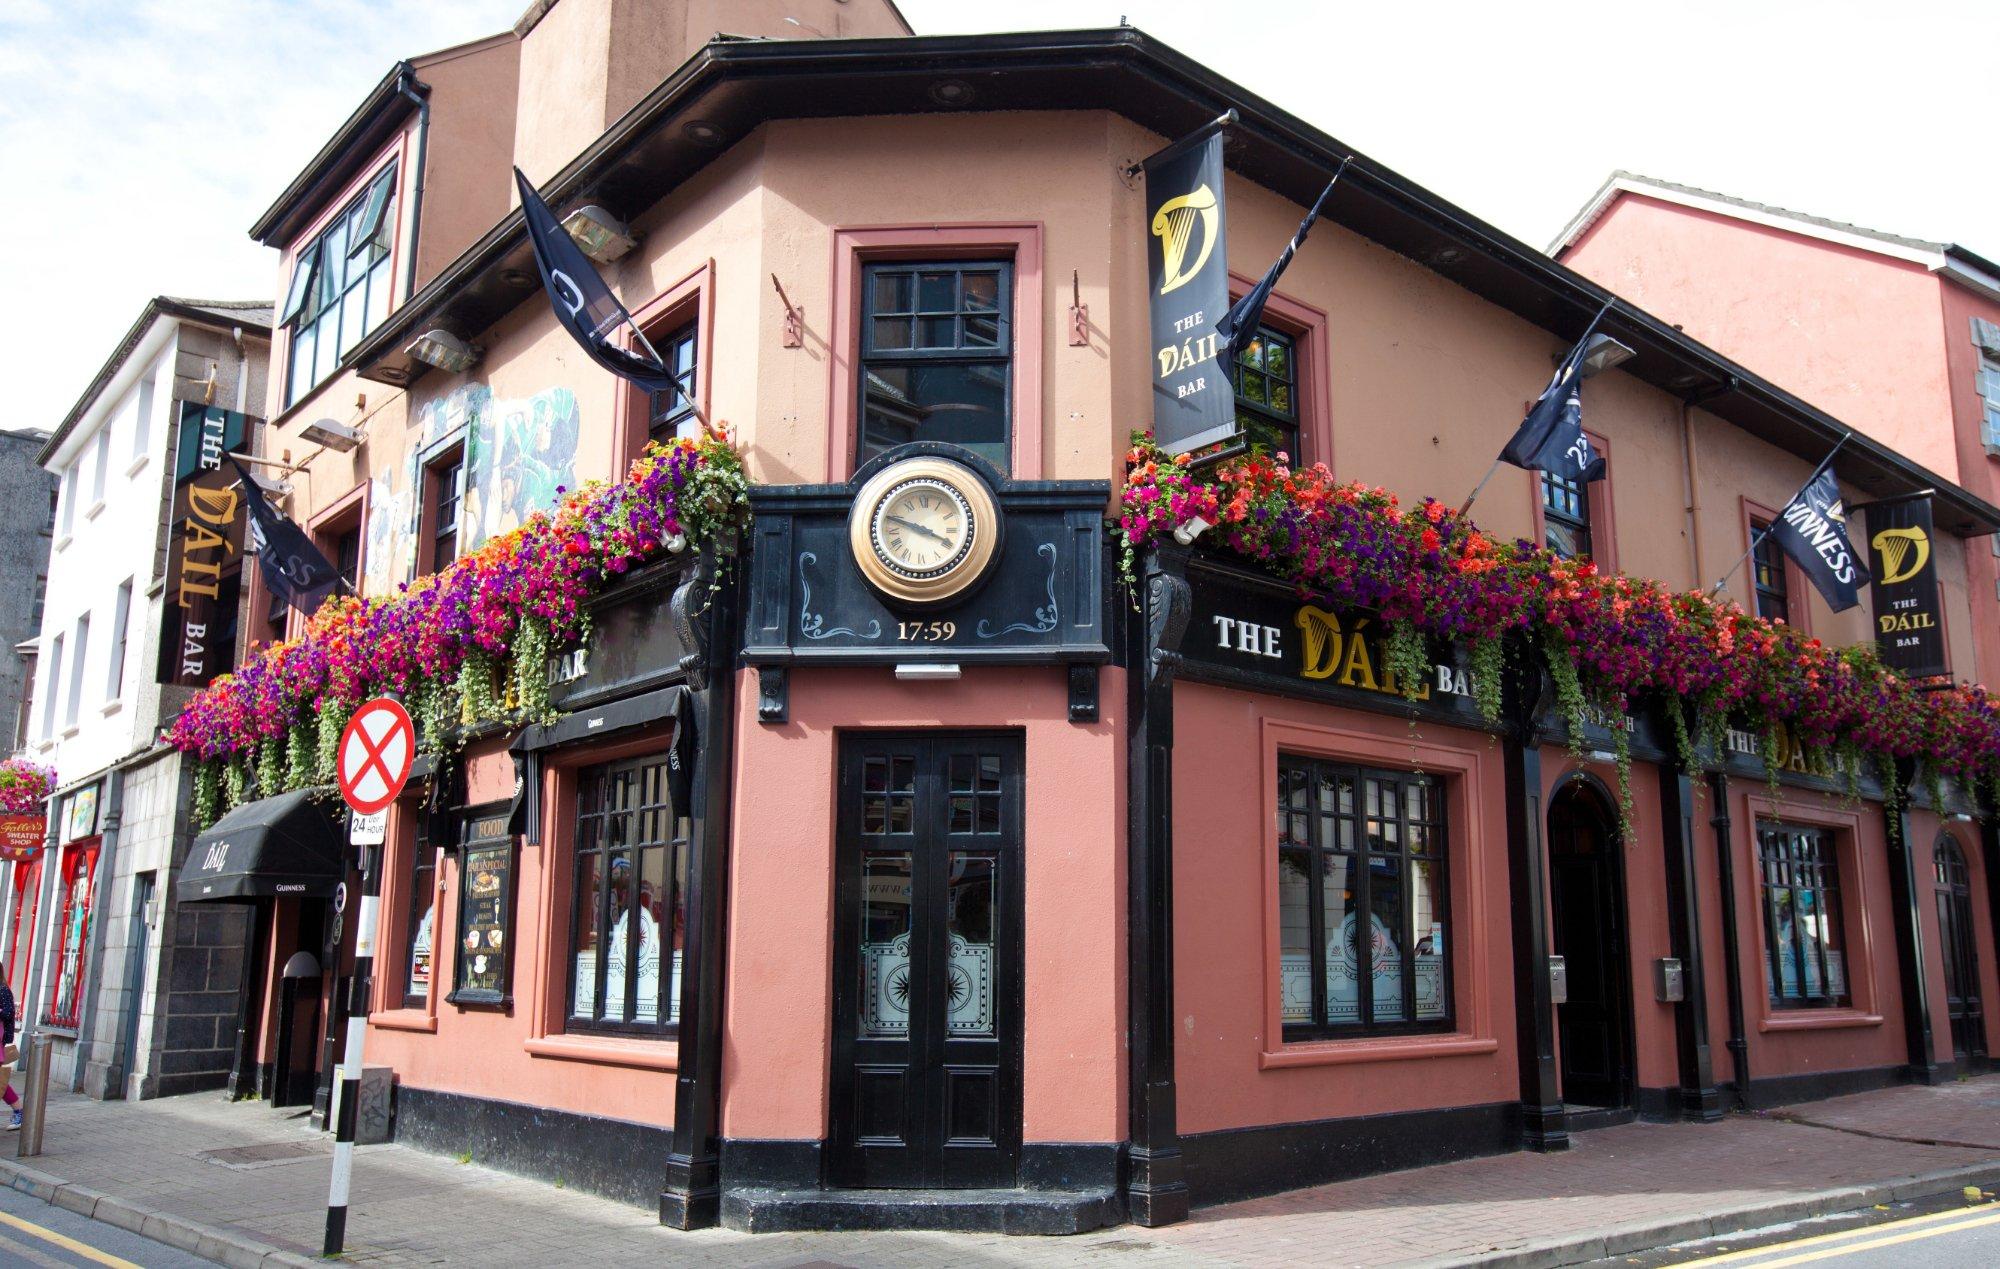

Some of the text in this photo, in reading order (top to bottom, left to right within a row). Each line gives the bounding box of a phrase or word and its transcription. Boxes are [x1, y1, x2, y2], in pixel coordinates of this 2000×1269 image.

[1174, 311, 1204, 334] THE
[1177, 377, 1206, 399] BAR
[200, 416, 225, 471] THE
[178, 483, 239, 609] DÁIL
[1892, 598, 1918, 610] THE
[897, 621, 956, 641] 17:59
[1879, 612, 1935, 634] DÁIL
[1213, 615, 1282, 659] THE
[1896, 636, 1920, 648] BAR
[182, 621, 207, 676] BAR
[548, 648, 589, 686] BAR
[353, 817, 366, 832] 24
[479, 819, 504, 837] FOOD
[7, 832, 40, 840] SWEATER
[276, 884, 306, 892] GUINNESS
